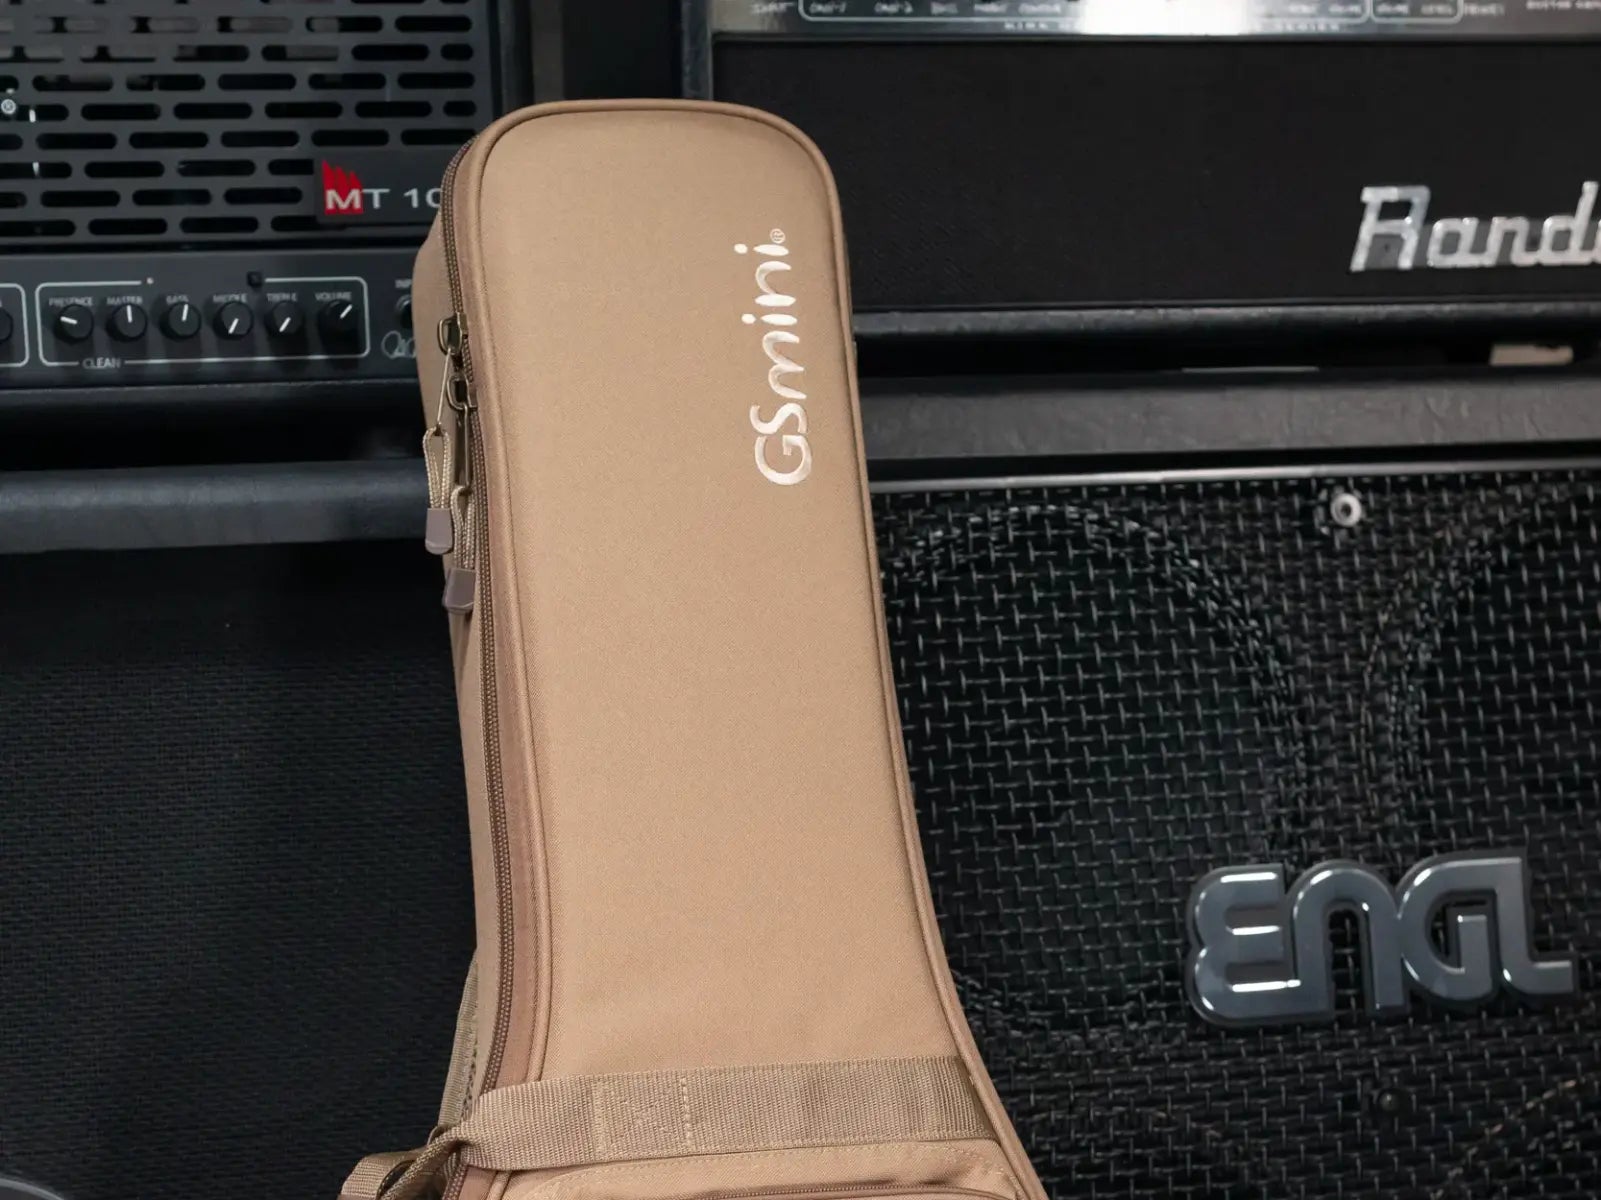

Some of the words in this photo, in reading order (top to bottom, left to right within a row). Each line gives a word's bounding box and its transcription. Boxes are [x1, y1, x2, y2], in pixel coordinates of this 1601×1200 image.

[325, 187, 391, 210] MT
[1350, 180, 1601, 273] Rand
[82, 357, 122, 370] CLEAN
